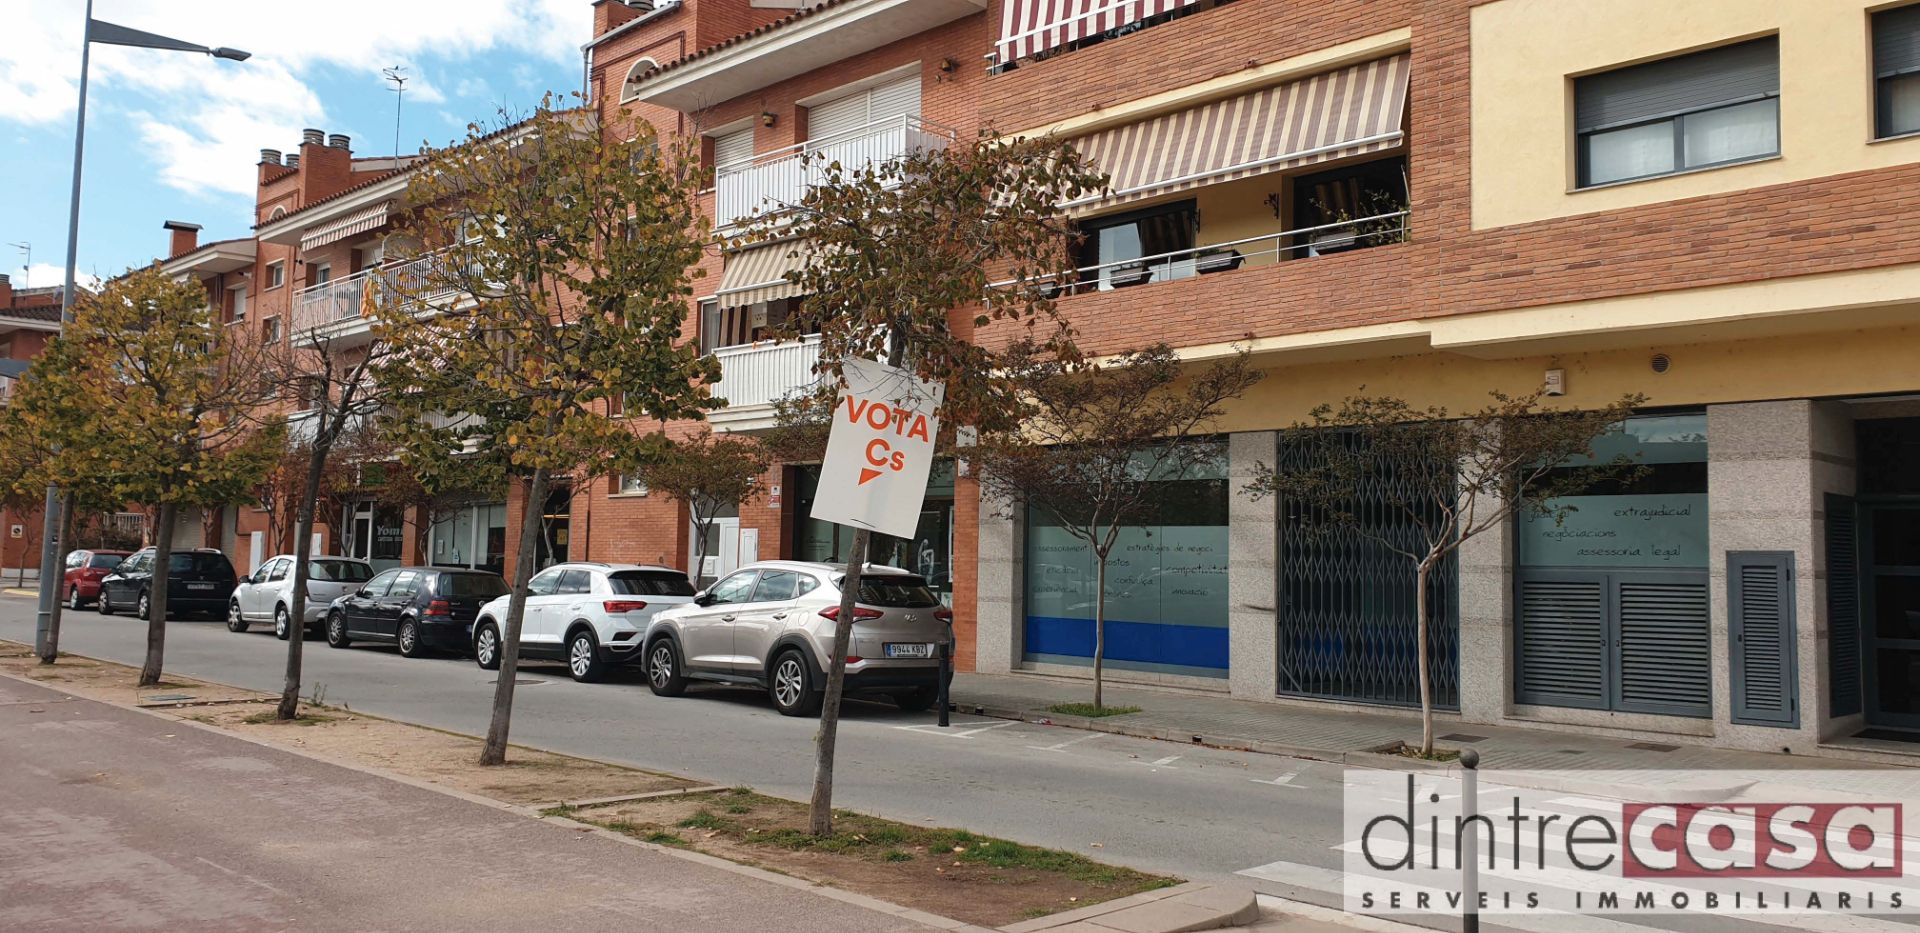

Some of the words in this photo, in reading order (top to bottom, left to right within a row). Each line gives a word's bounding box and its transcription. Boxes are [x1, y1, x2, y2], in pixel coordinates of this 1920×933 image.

[847, 395, 929, 443] VOTA
[865, 438, 905, 471] Cs
[1613, 503, 1691, 521] extrajudicial
[1577, 545, 1641, 556] assessoria
[1651, 544, 1681, 560] legal
[912, 645, 924, 654] KBZ
